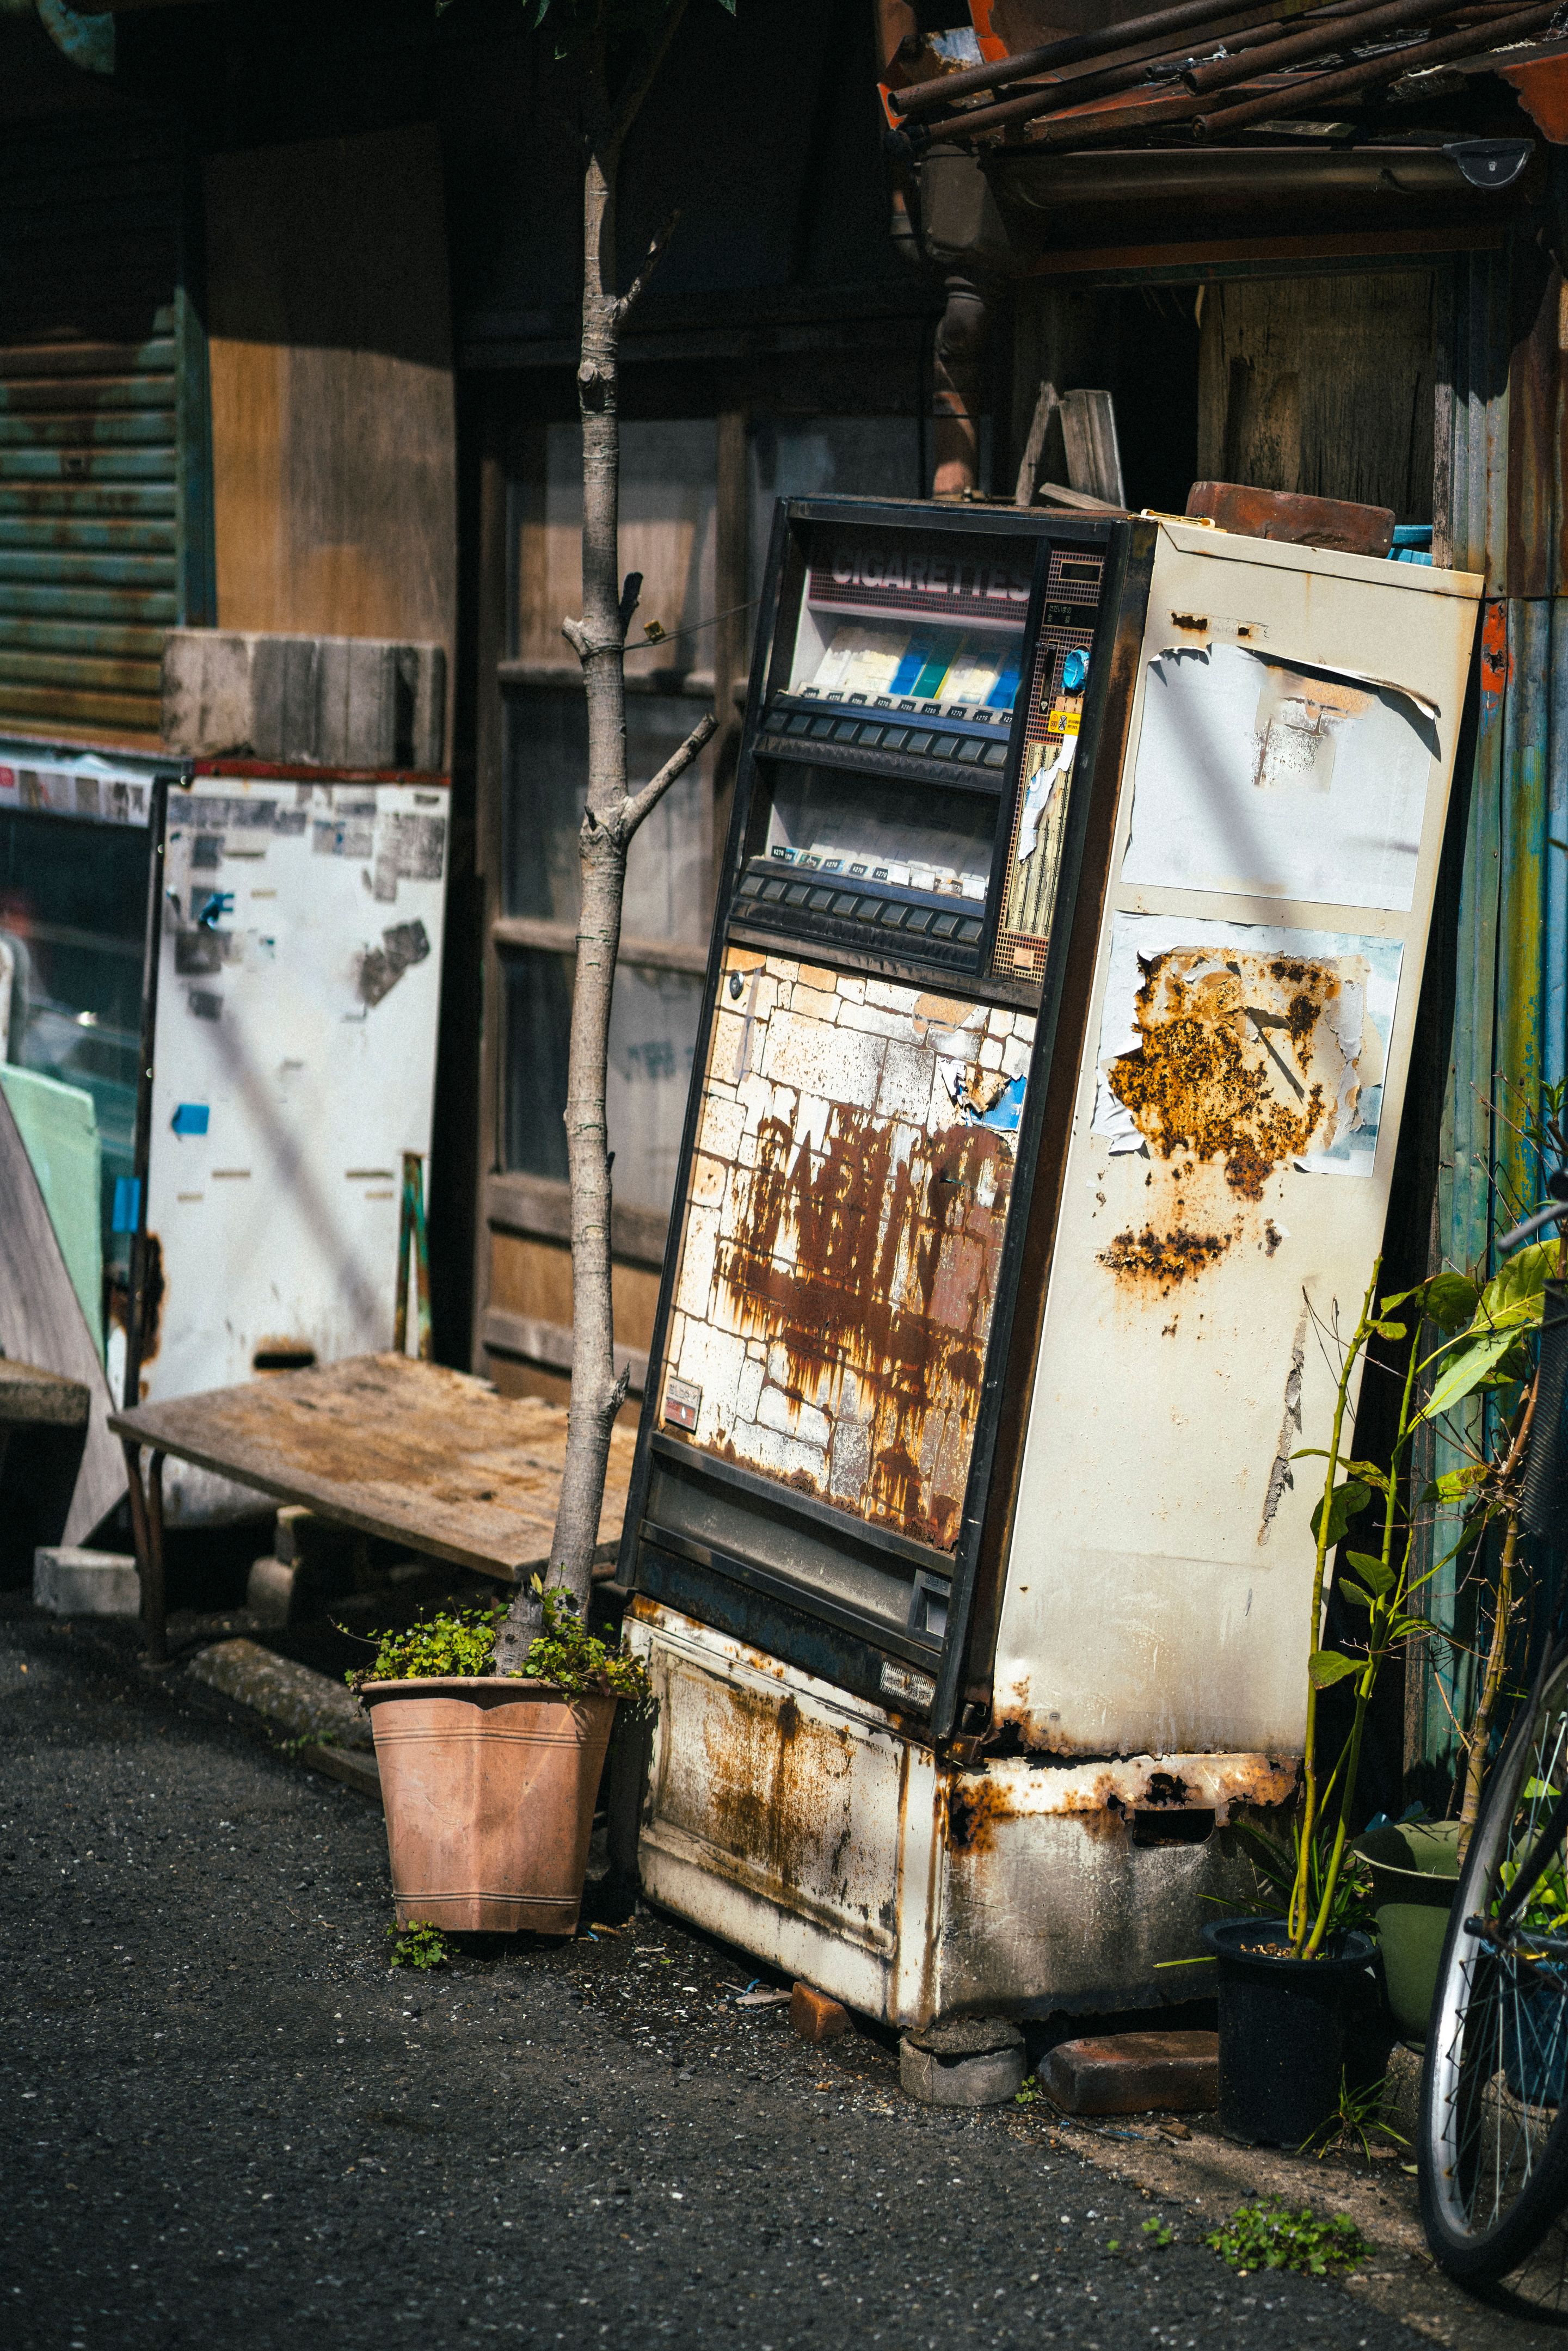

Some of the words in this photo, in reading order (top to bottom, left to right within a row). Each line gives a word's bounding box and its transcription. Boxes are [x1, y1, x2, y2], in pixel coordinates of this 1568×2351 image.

[1048, 605, 1072, 614] ただいまの
[773, 848, 784, 857] ¥270
[852, 866, 863, 874] ¥270
